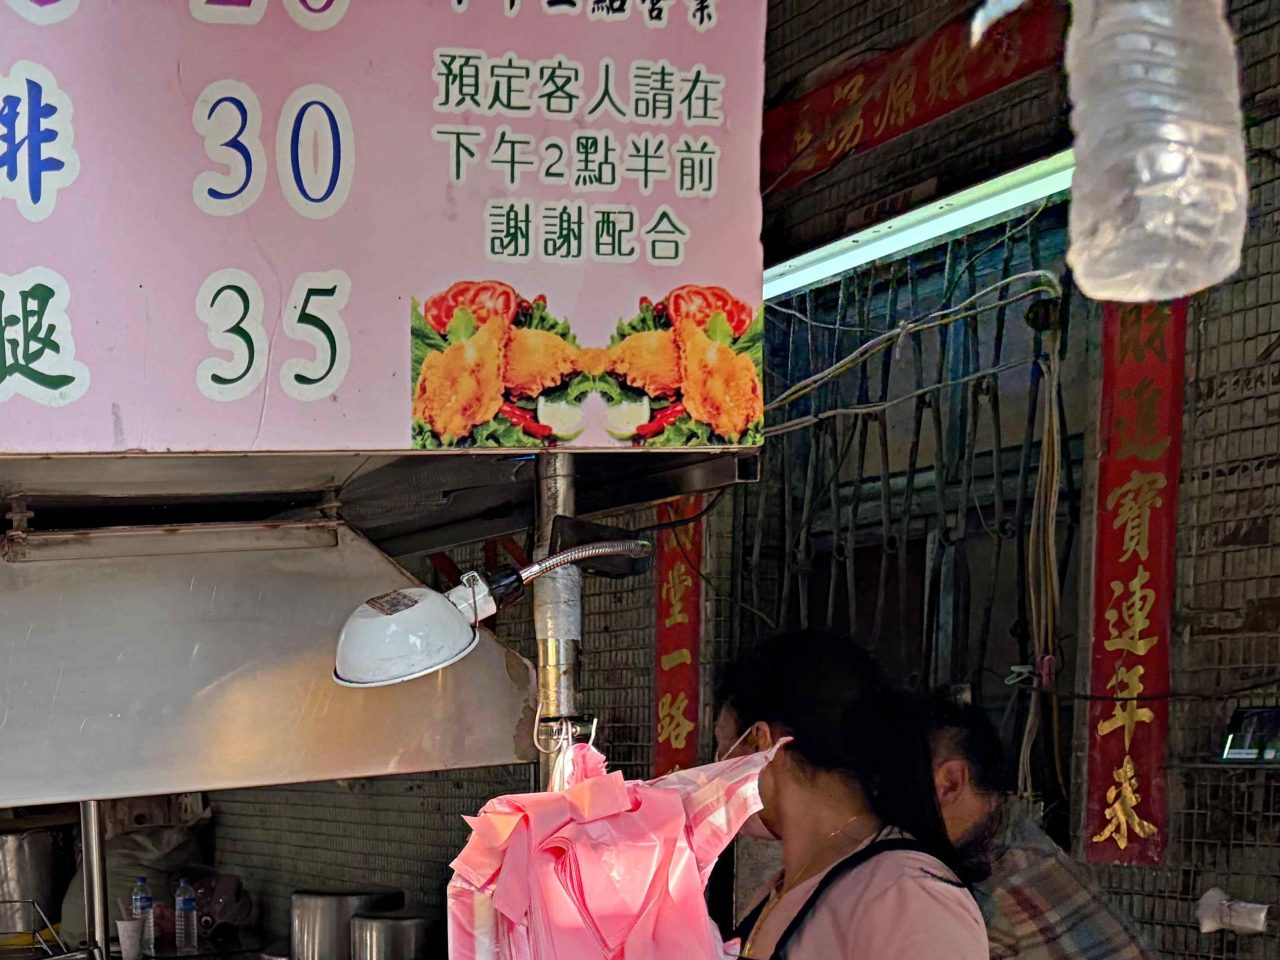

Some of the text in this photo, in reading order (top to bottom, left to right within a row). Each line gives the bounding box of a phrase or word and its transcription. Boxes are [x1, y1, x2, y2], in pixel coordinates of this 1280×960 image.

[437, 54, 721, 120] 預定客人請在
[207, 96, 341, 203] 30
[436, 131, 716, 191] 下午2點半前
[489, 204, 686, 260] 謝謝配合
[210, 284, 337, 385] 35
